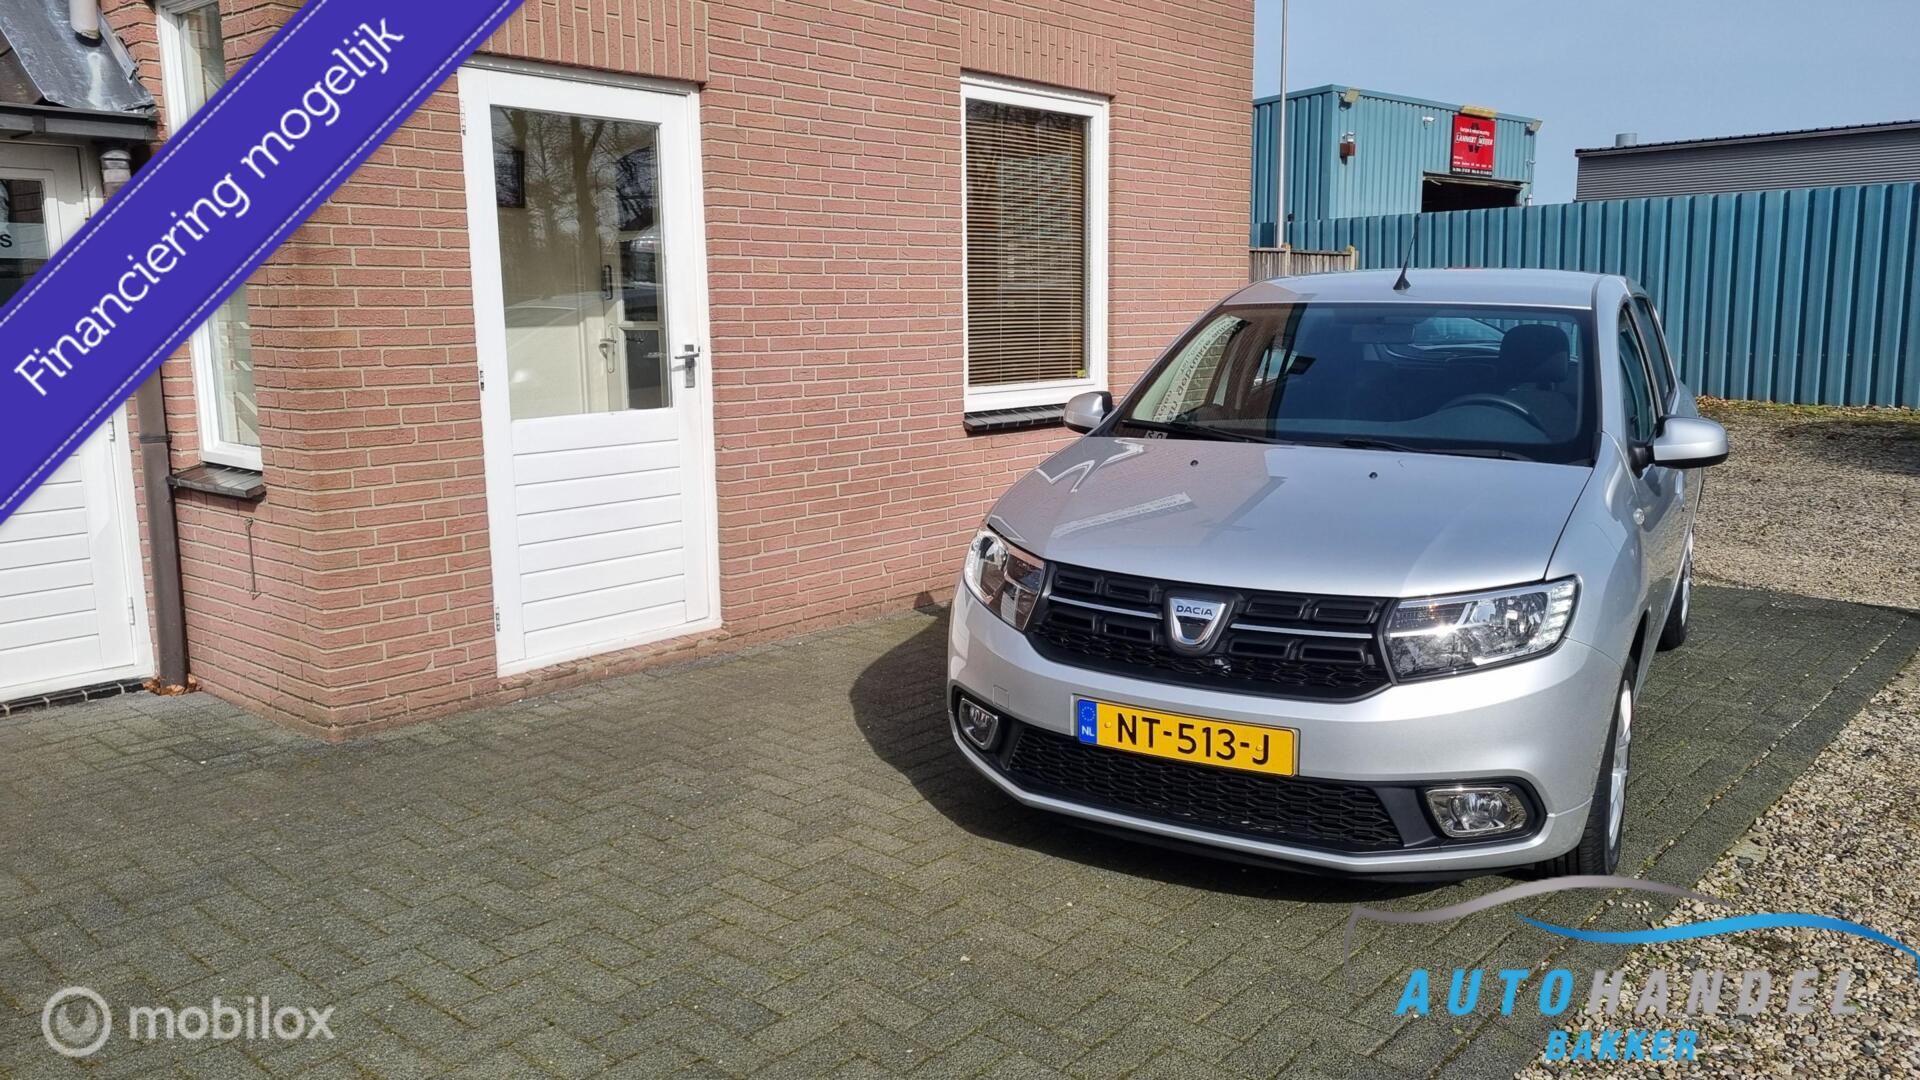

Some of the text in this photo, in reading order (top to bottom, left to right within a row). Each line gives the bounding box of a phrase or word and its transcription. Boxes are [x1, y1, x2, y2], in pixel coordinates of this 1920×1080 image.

[1176, 605, 1213, 617] DACIA
[1081, 713, 1270, 766] NL NT-513-J
